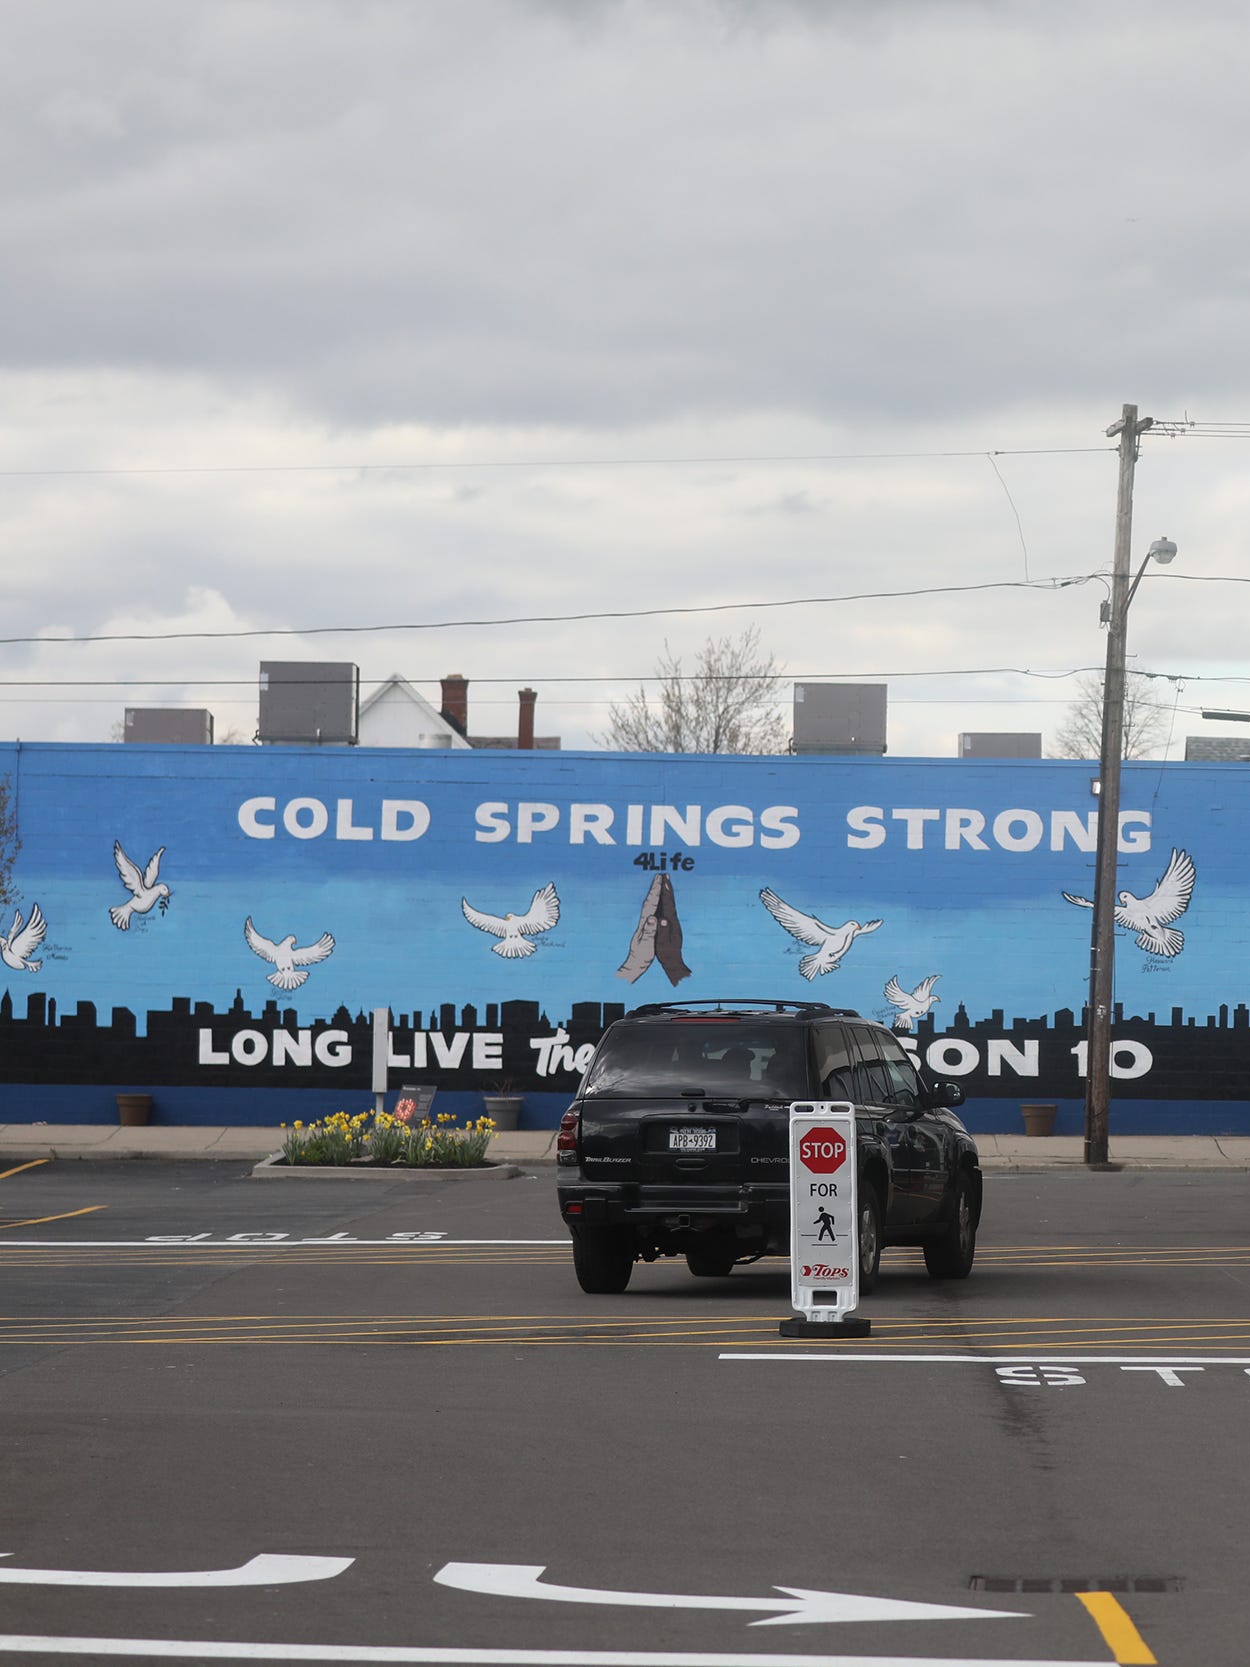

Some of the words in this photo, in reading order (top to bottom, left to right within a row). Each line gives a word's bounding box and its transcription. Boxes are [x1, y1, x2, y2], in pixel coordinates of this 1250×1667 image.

[238, 797, 431, 842] COLD
[474, 802, 800, 849] SPRINGS
[847, 806, 1152, 853] STRONG
[632, 852, 695, 872] 4Life
[198, 1028, 352, 1068] LONG
[387, 1031, 503, 1070] LIVE
[530, 1028, 597, 1077] The
[895, 1036, 1040, 1077] SON
[1070, 1038, 1154, 1079] 10
[673, 1134, 688, 1147] APB
[693, 1134, 713, 1147] 9392
[802, 1142, 844, 1159] STOP
[809, 1183, 838, 1197] FOR
